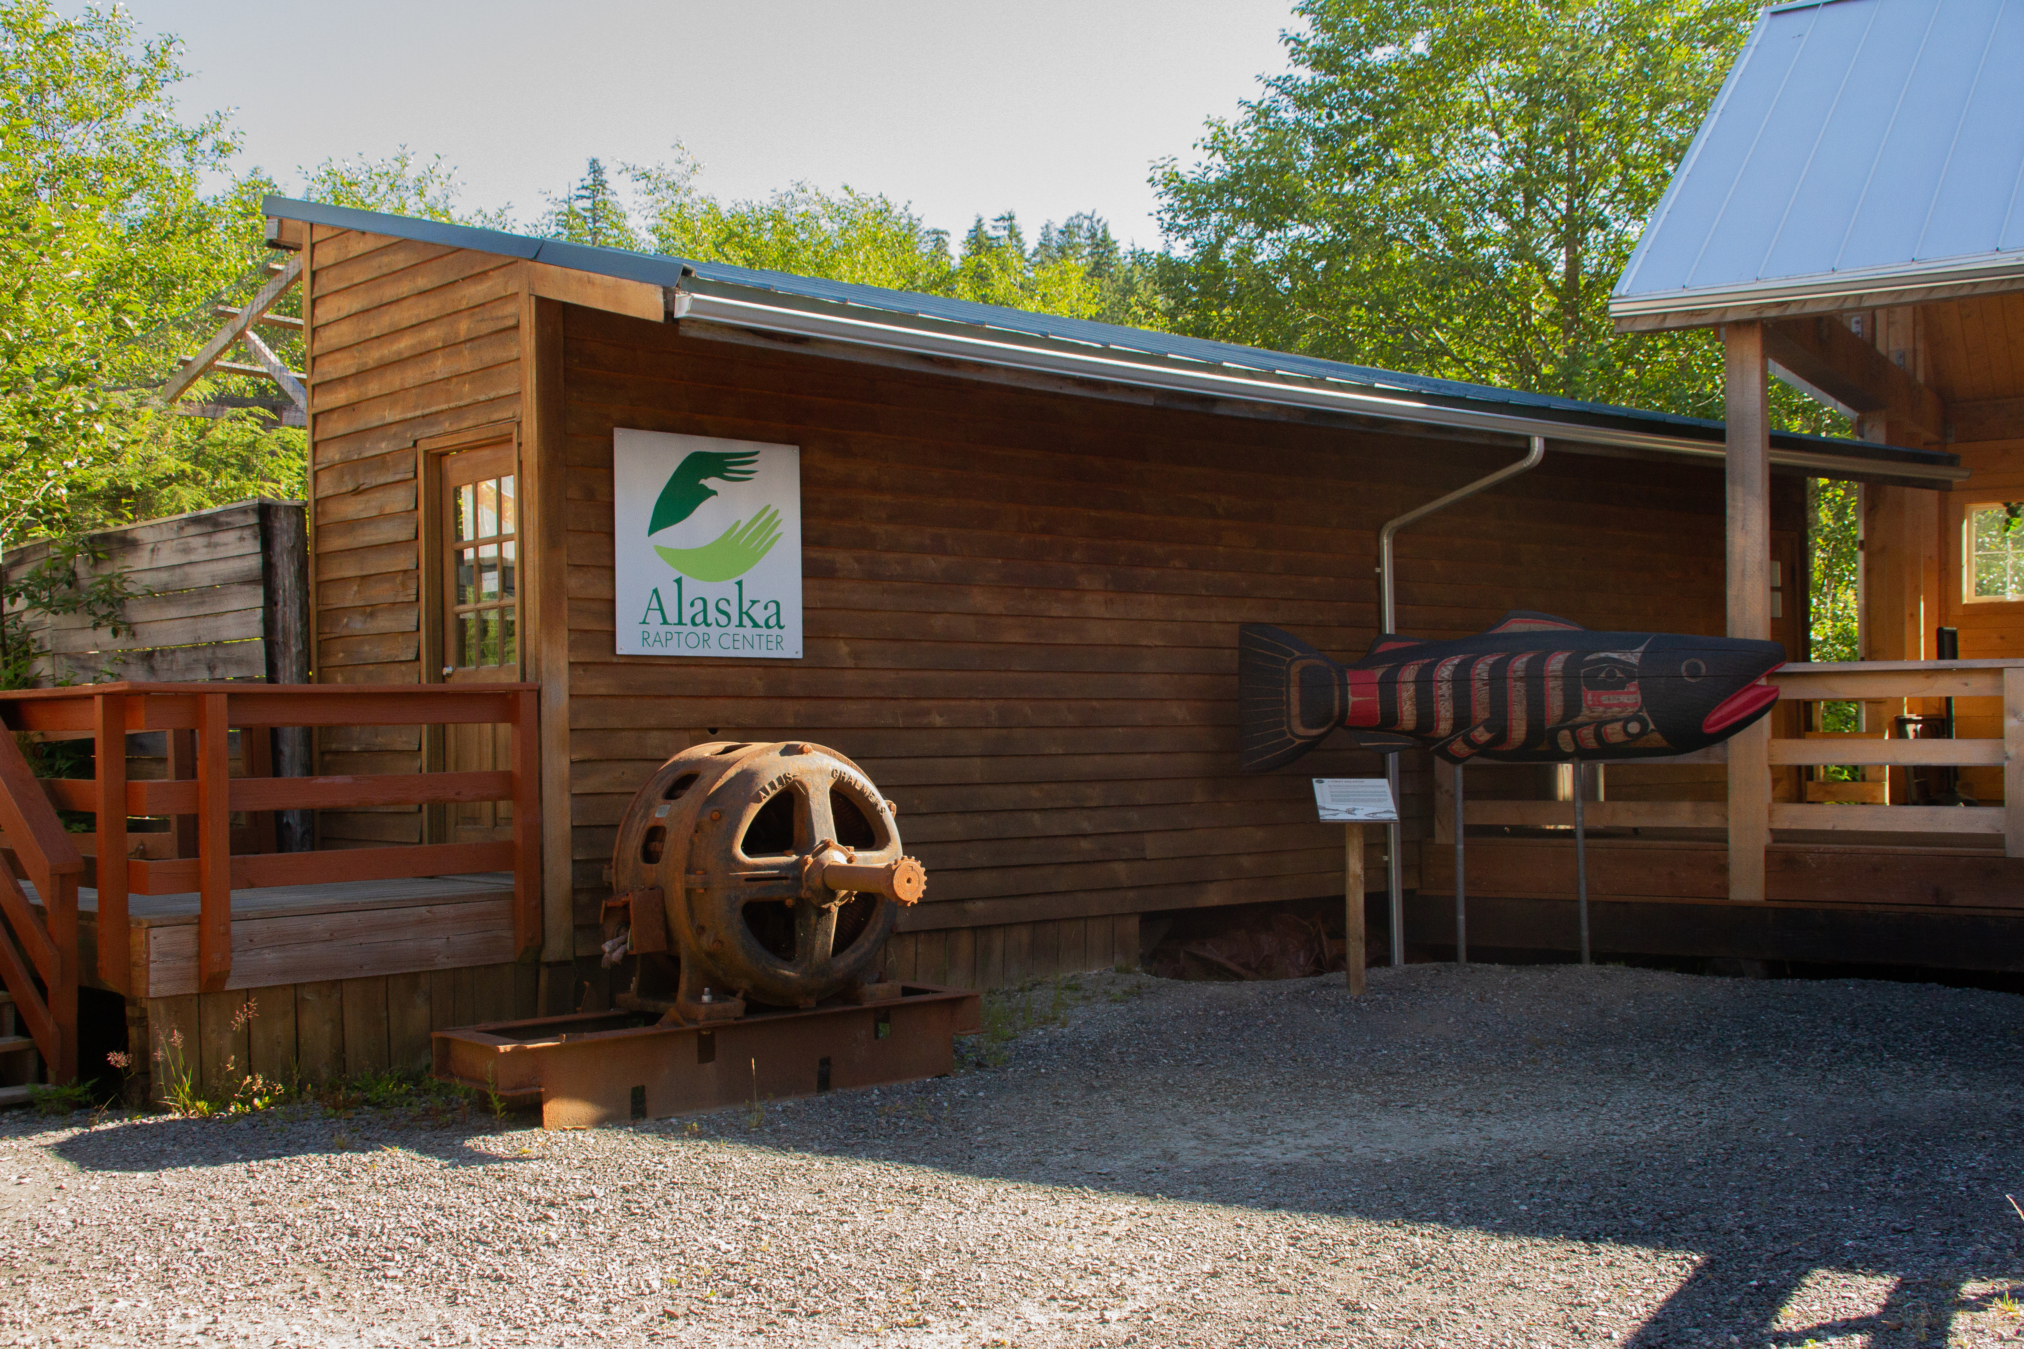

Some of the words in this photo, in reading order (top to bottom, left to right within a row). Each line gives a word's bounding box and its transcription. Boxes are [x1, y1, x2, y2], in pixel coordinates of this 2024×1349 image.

[639, 576, 786, 630] Alaska
[641, 631, 711, 649] RAPTOR
[718, 633, 784, 650] CENTER
[831, 769, 886, 818] CHALMERS
